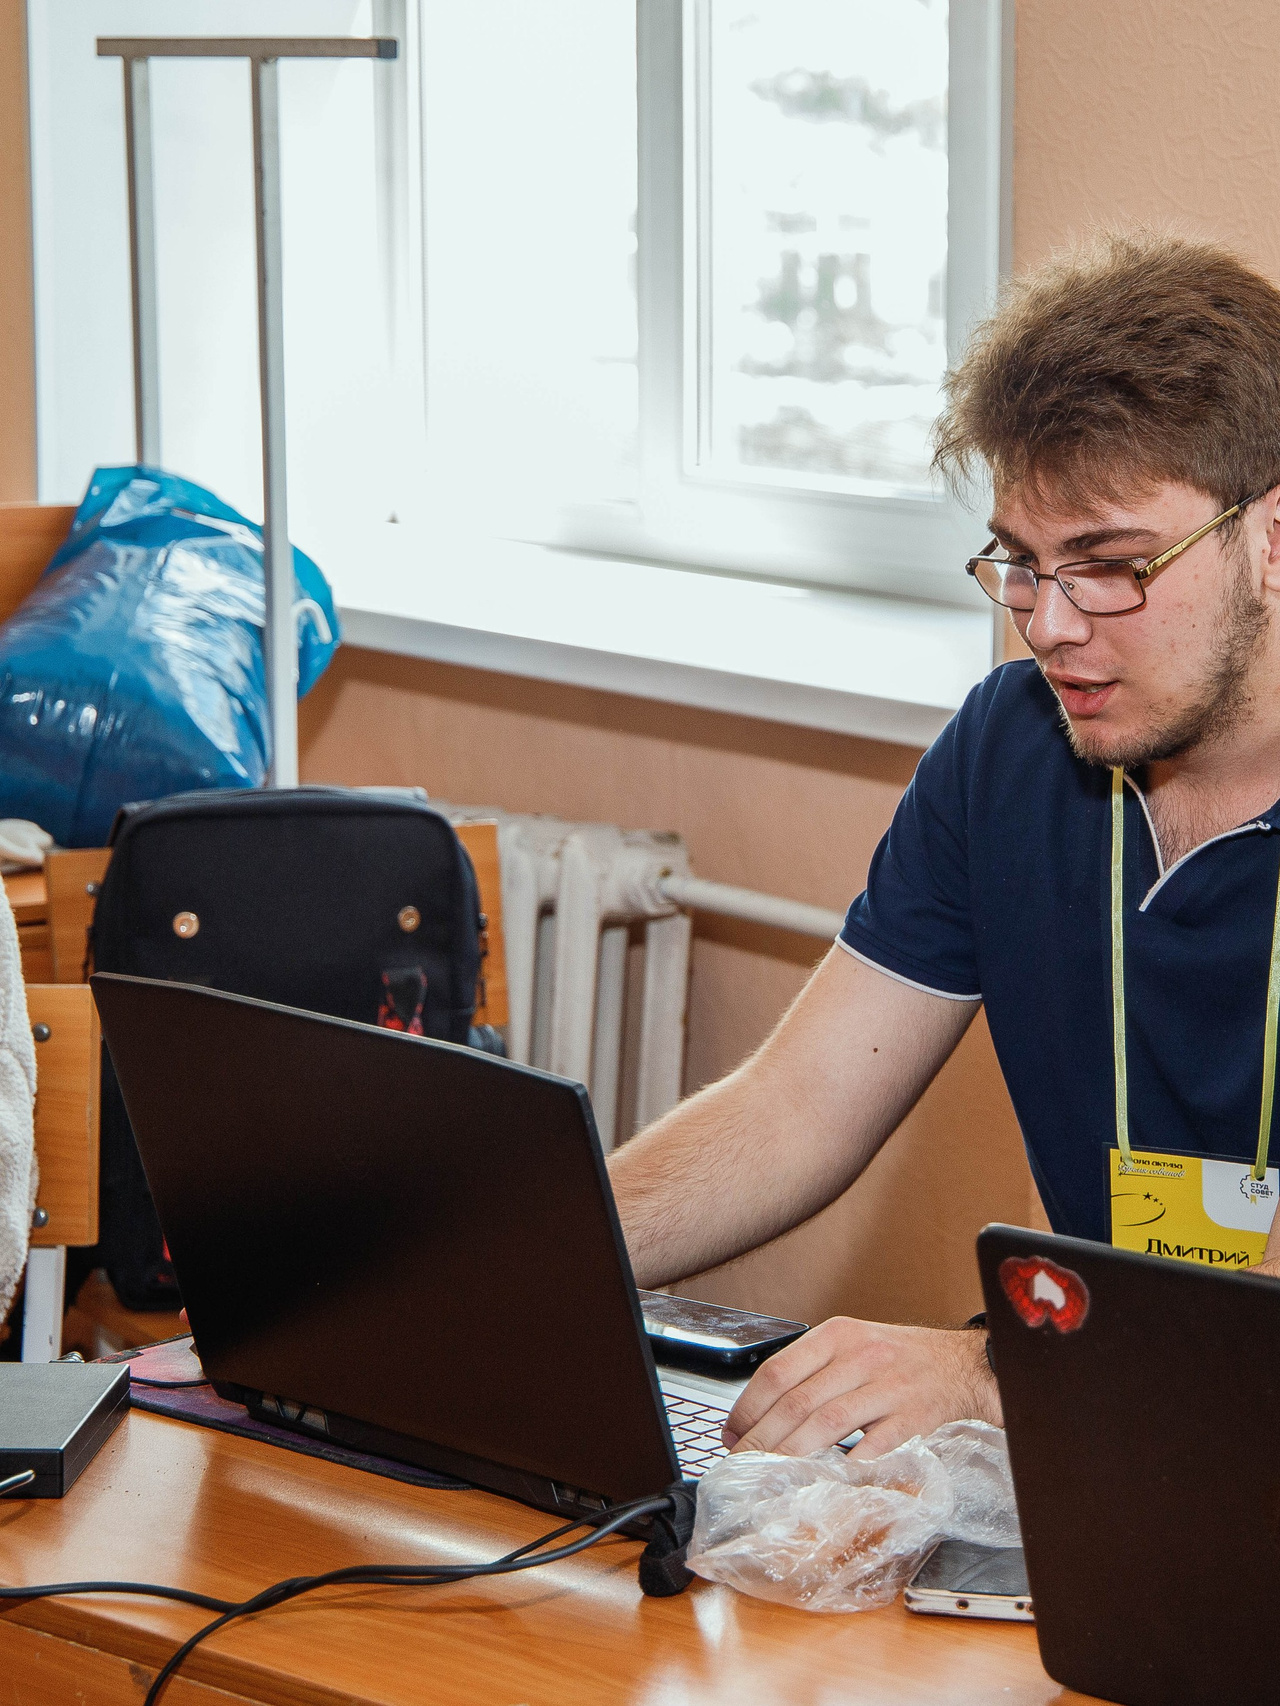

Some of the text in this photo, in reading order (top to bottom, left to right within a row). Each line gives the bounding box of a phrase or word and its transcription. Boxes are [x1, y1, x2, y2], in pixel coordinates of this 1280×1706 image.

[1120, 1156, 1183, 1169] ола актива
[1250, 1182, 1269, 1190] СТУД
[1250, 1188, 1274, 1196] СОВЕТ
[1145, 1238, 1250, 1266] Дмитрий
